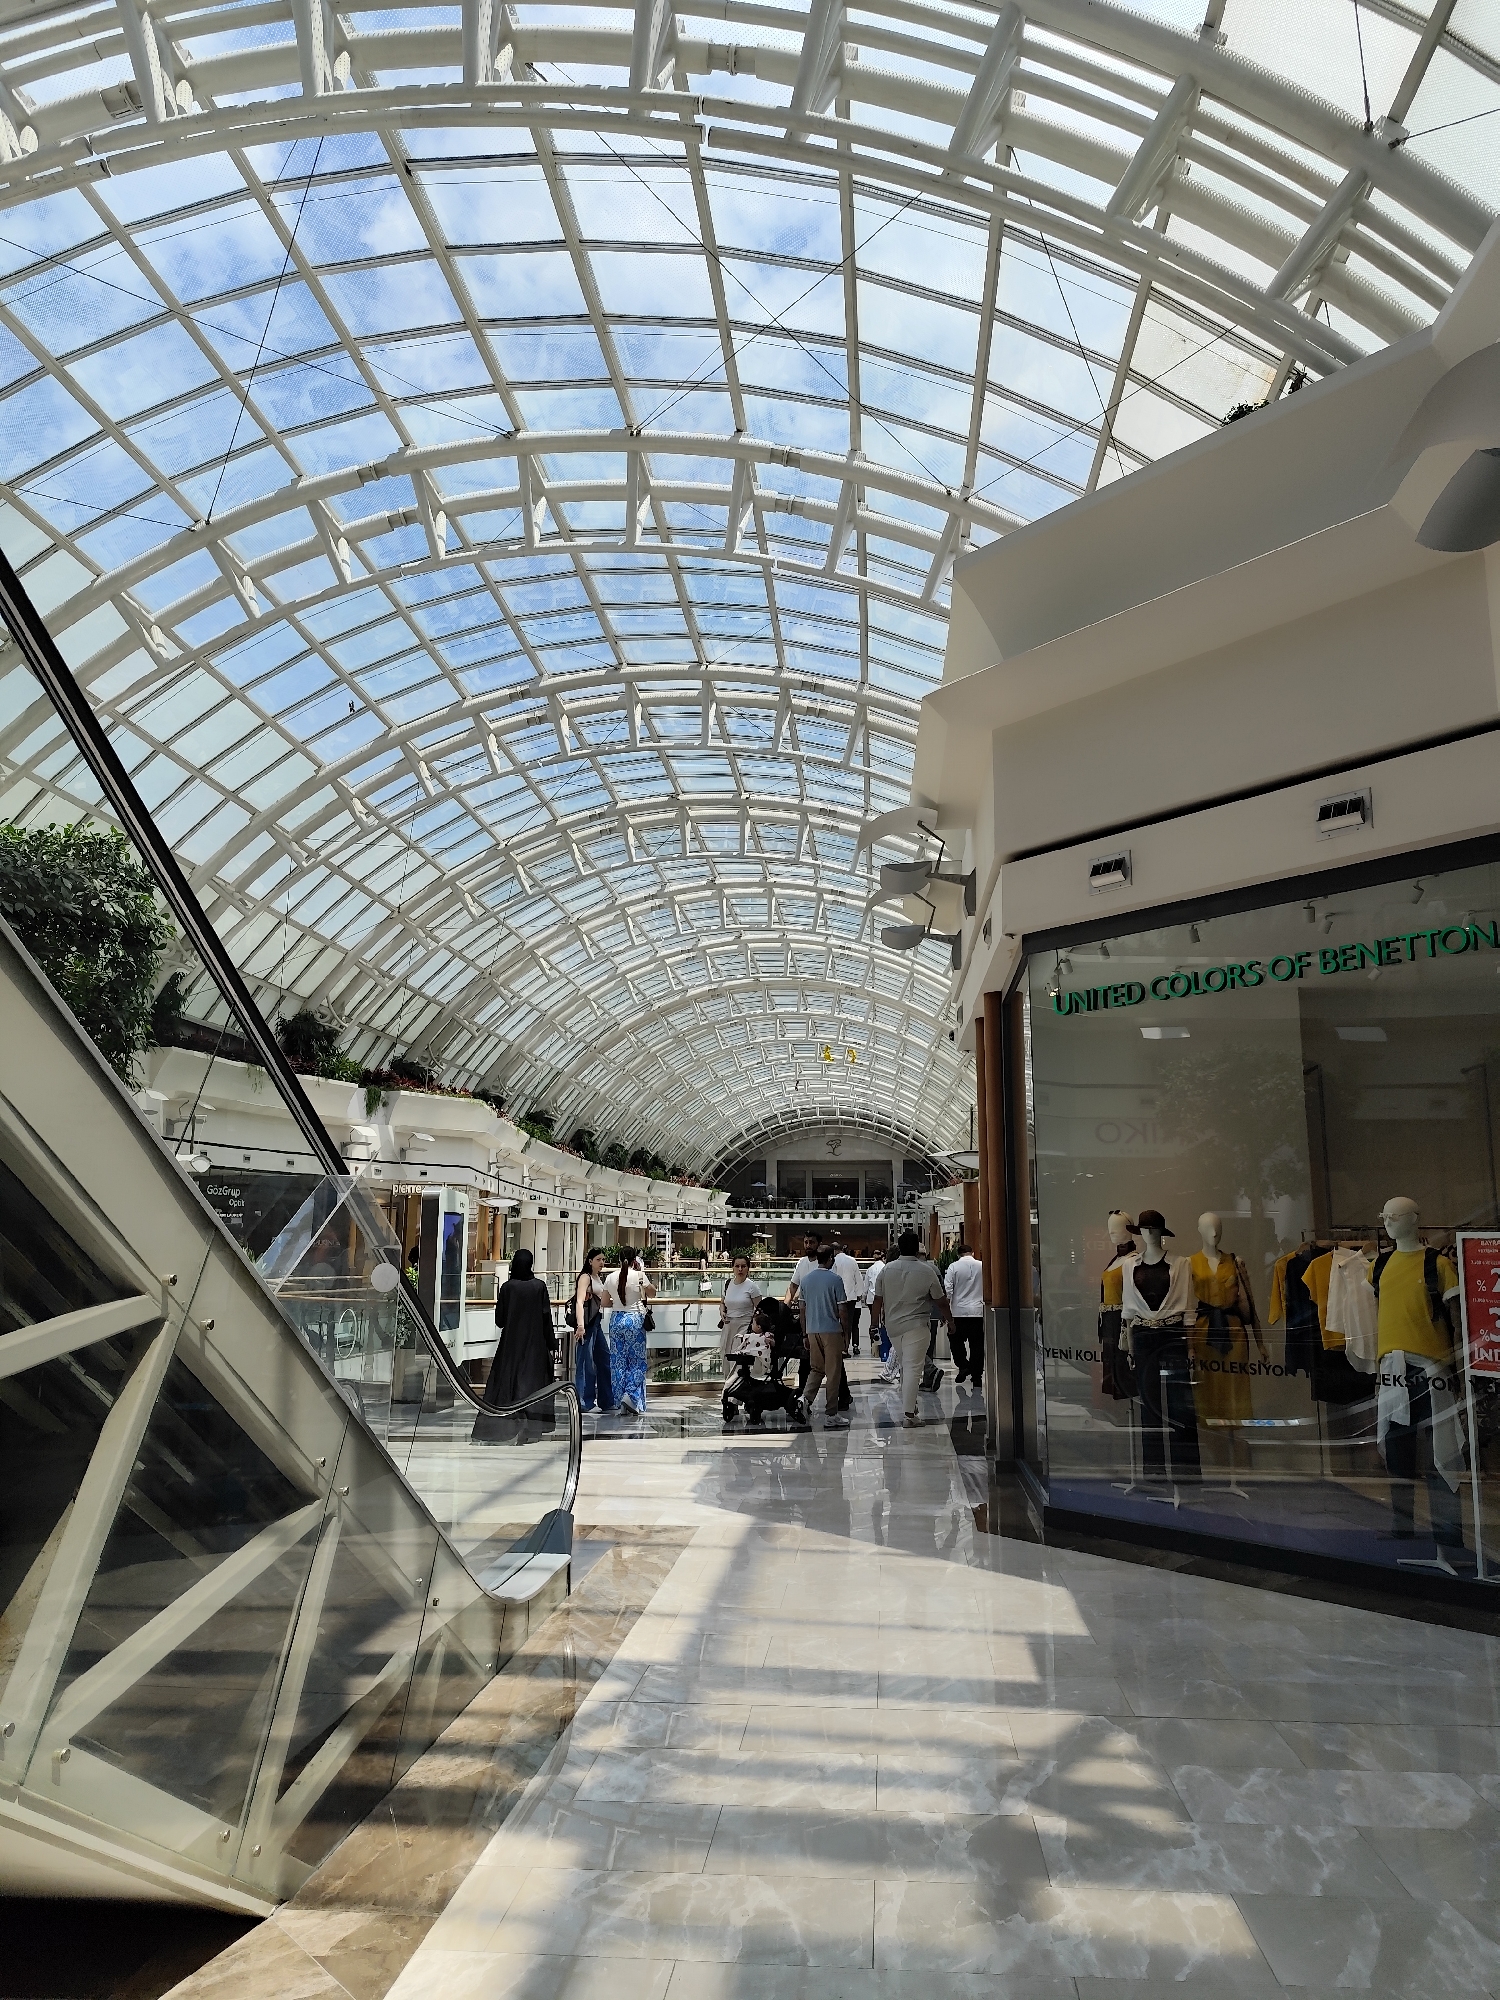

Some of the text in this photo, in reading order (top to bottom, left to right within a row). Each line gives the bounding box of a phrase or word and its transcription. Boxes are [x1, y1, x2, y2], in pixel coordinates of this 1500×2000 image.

[1053, 921, 1500, 1015] UNITED COLORS OF BENETTON
[206, 1184, 241, 1199] GözGrup
[1043, 1346, 1072, 1360] YENİ
